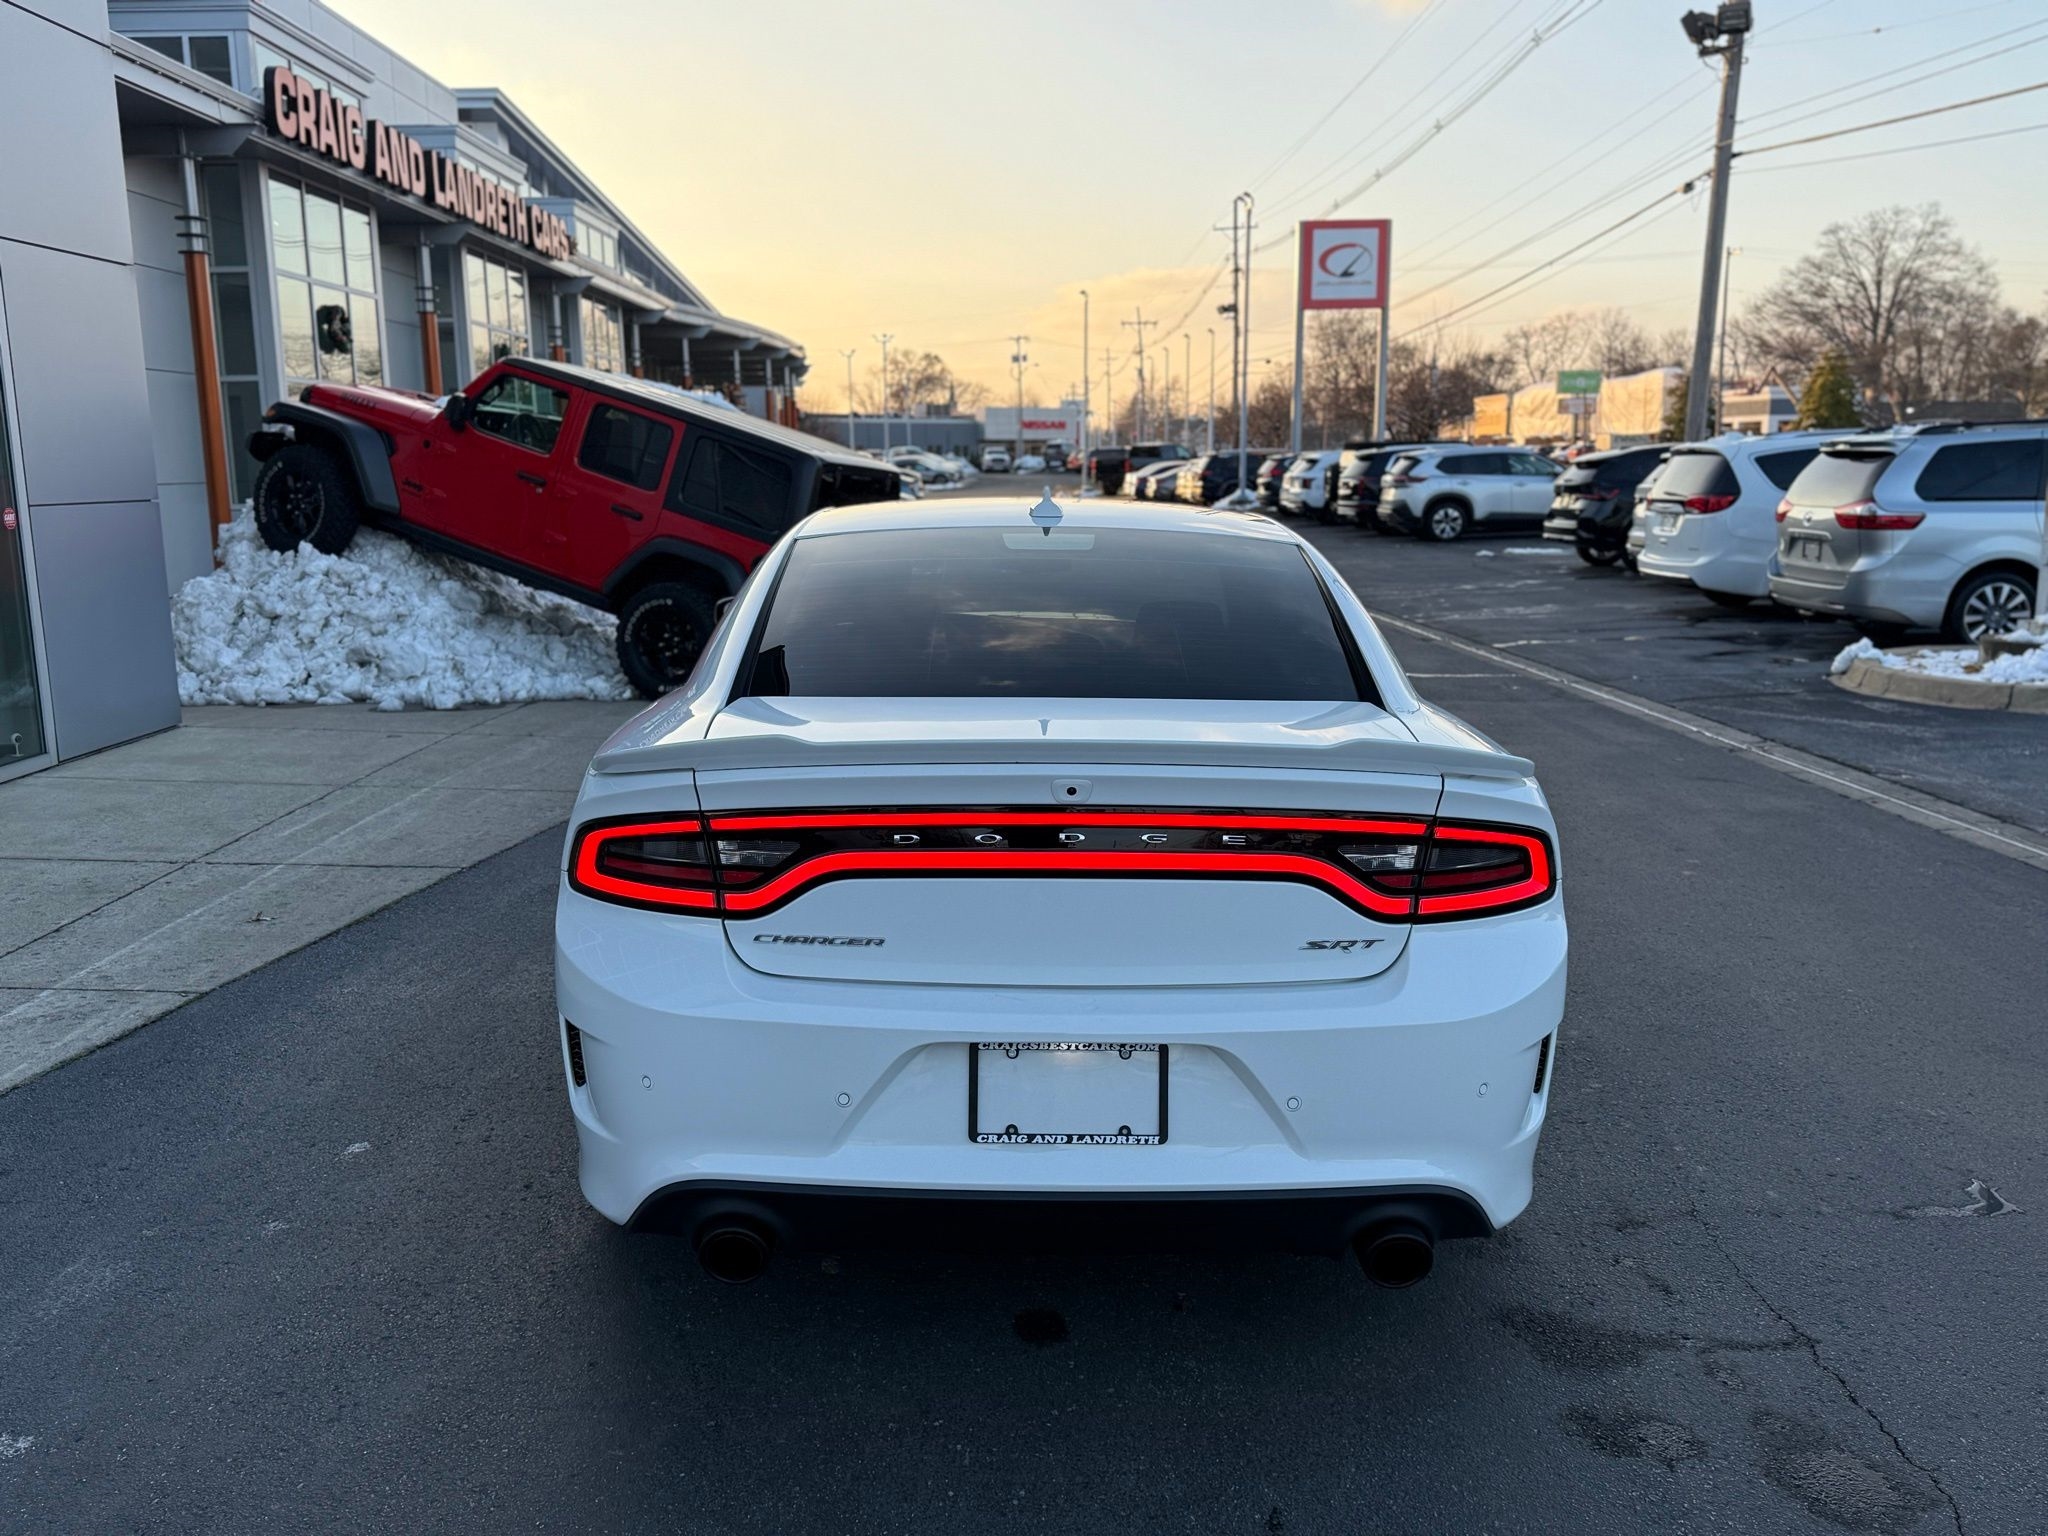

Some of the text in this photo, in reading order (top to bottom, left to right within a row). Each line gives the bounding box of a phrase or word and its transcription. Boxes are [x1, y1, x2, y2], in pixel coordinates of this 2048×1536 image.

[273, 65, 570, 262] CRAIG AND LANDRETH CARS
[893, 832, 1247, 846] DODGE
[753, 934, 886, 946] CHARGER
[1298, 939, 1385, 953] SRT
[977, 1042, 1160, 1051] CRAIGSBESTCARS.COM
[976, 1134, 1160, 1145] CRAIG AND LANDRETH
